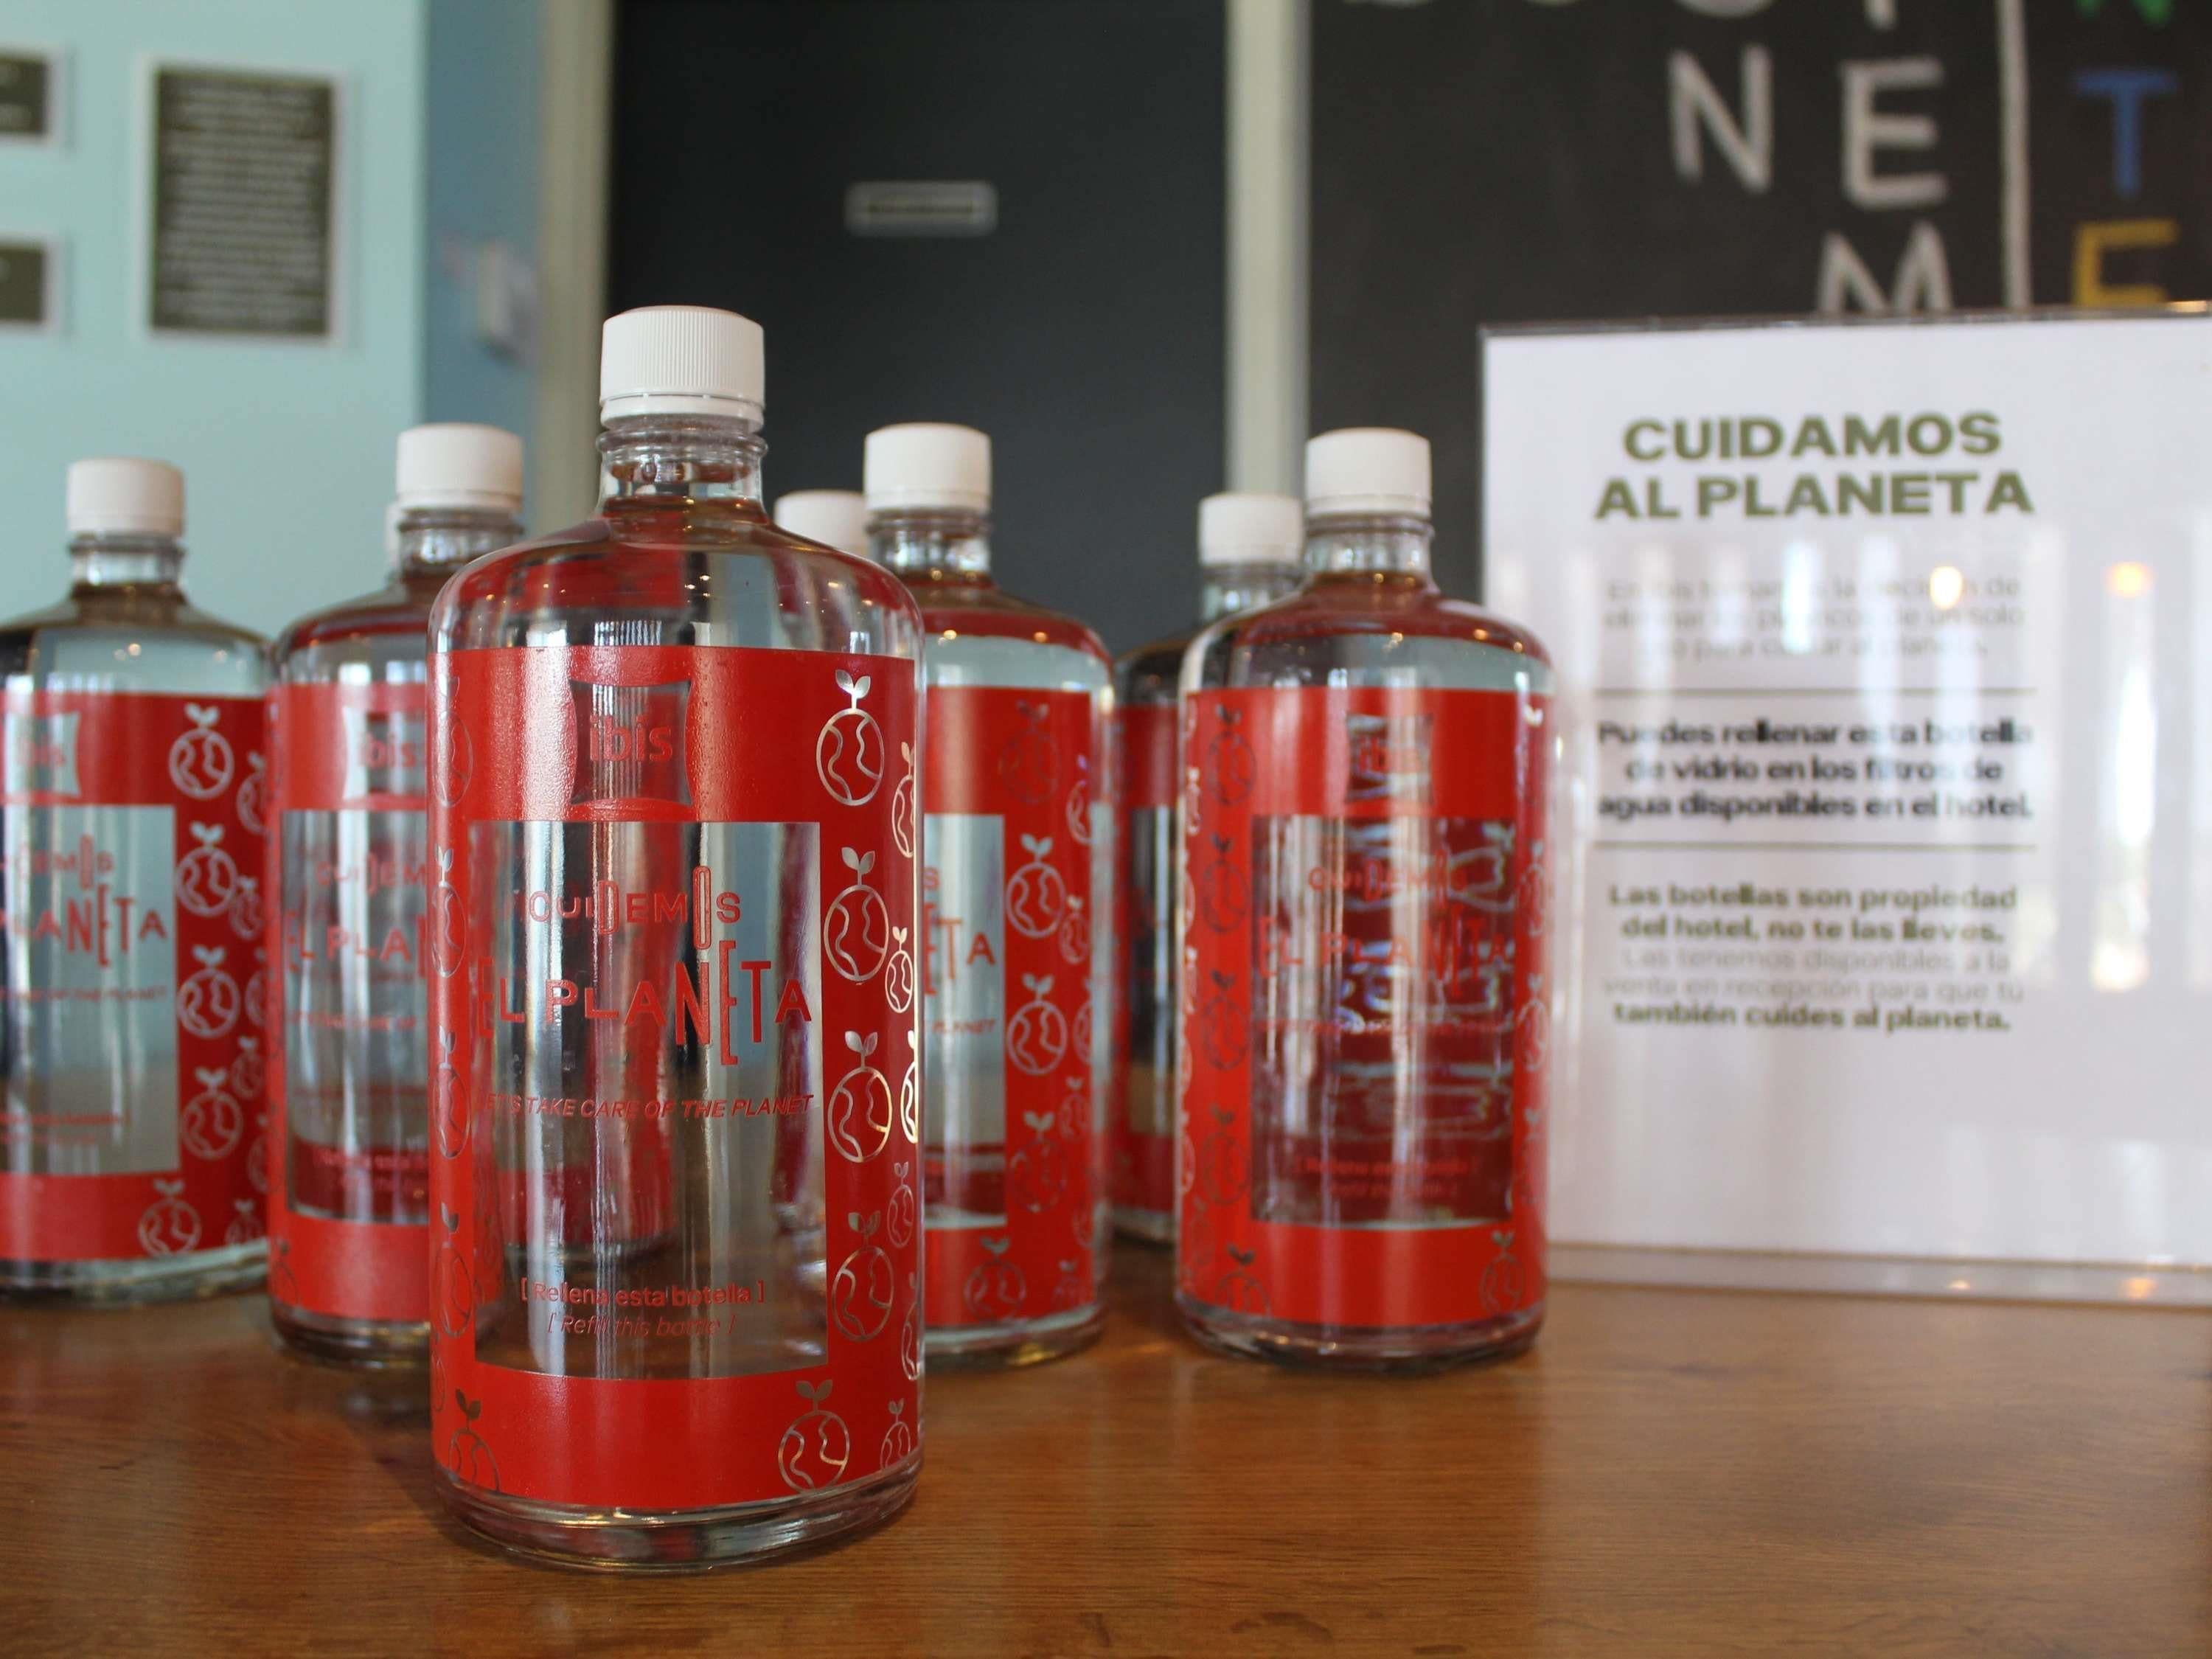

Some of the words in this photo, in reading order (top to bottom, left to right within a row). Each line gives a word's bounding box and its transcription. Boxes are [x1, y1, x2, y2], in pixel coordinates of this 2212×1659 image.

[1624, 413, 2002, 462] CUIDAMOS
[1596, 477, 1680, 520] AL
[1697, 471, 2034, 518] PLANETA
[590, 713, 673, 762] ibis
[1767, 760, 1806, 780] en
[1811, 754, 1857, 780] los
[1598, 796, 1671, 821] agua
[1679, 790, 1857, 824] disponibles
[528, 865, 741, 950] CUIDEMOS
[1607, 882, 1662, 905] Las
[1668, 882, 1790, 906] botellas
[1797, 888, 1851, 907] son
[1860, 883, 2017, 912] propiedad
[1620, 913, 1666, 939] del
[1767, 921, 1806, 939] no
[1812, 918, 1843, 940] te
[1850, 917, 1893, 942] las
[546, 939, 813, 1065] PLANETA
[1613, 1001, 1736, 1024] también
[1745, 1002, 1846, 1026] cuides
[1852, 1005, 1878, 1027] al
[1885, 1004, 2011, 1034] planeta.
[526, 1096, 578, 1118] TAKE
[580, 1099, 641, 1119] CARE
[644, 1099, 676, 1119] OF
[681, 1099, 726, 1119] THE
[731, 1093, 815, 1117] PLANET
[532, 1281, 611, 1305] Rellena
[616, 1286, 665, 1307] esta
[672, 1283, 753, 1307] botella
